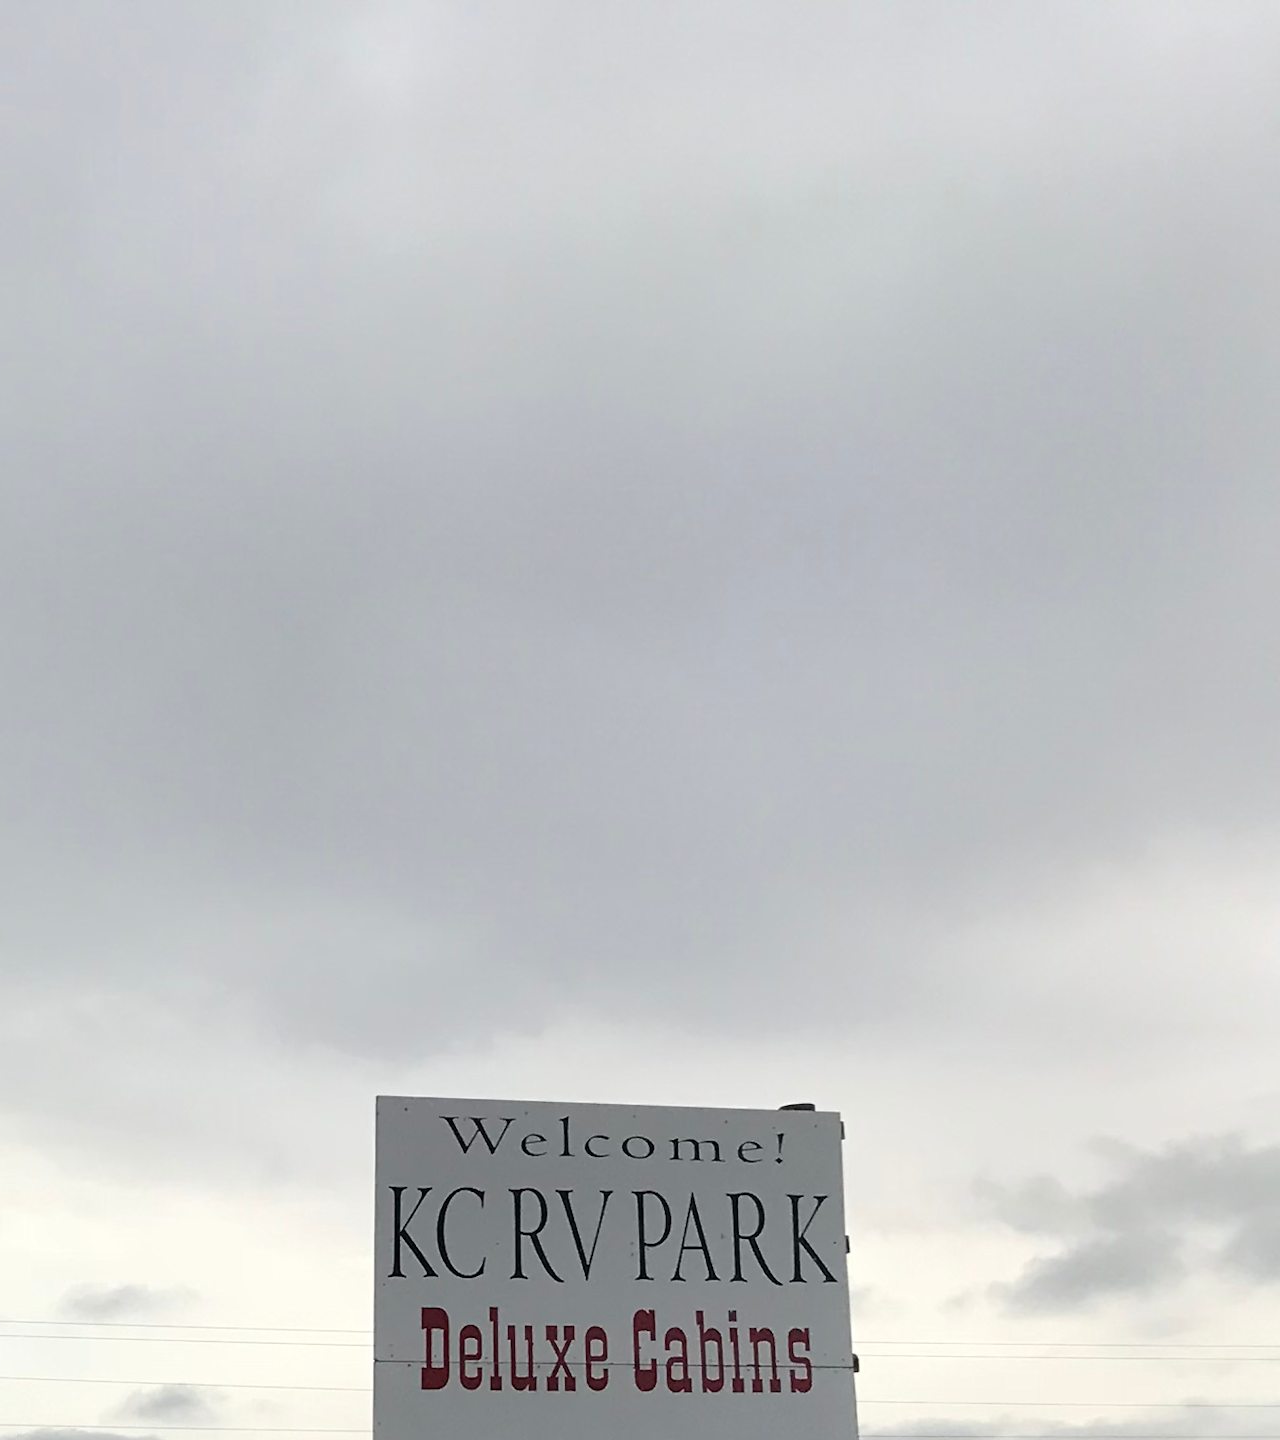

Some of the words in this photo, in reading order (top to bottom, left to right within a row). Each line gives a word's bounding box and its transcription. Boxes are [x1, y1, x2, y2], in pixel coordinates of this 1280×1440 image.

[439, 1115, 786, 1164] Welcome!
[387, 1186, 487, 1279] KC
[508, 1187, 614, 1283] RV
[631, 1190, 839, 1286] PARK
[420, 1306, 610, 1392] Deluxe
[632, 1308, 813, 1394] Cabins
